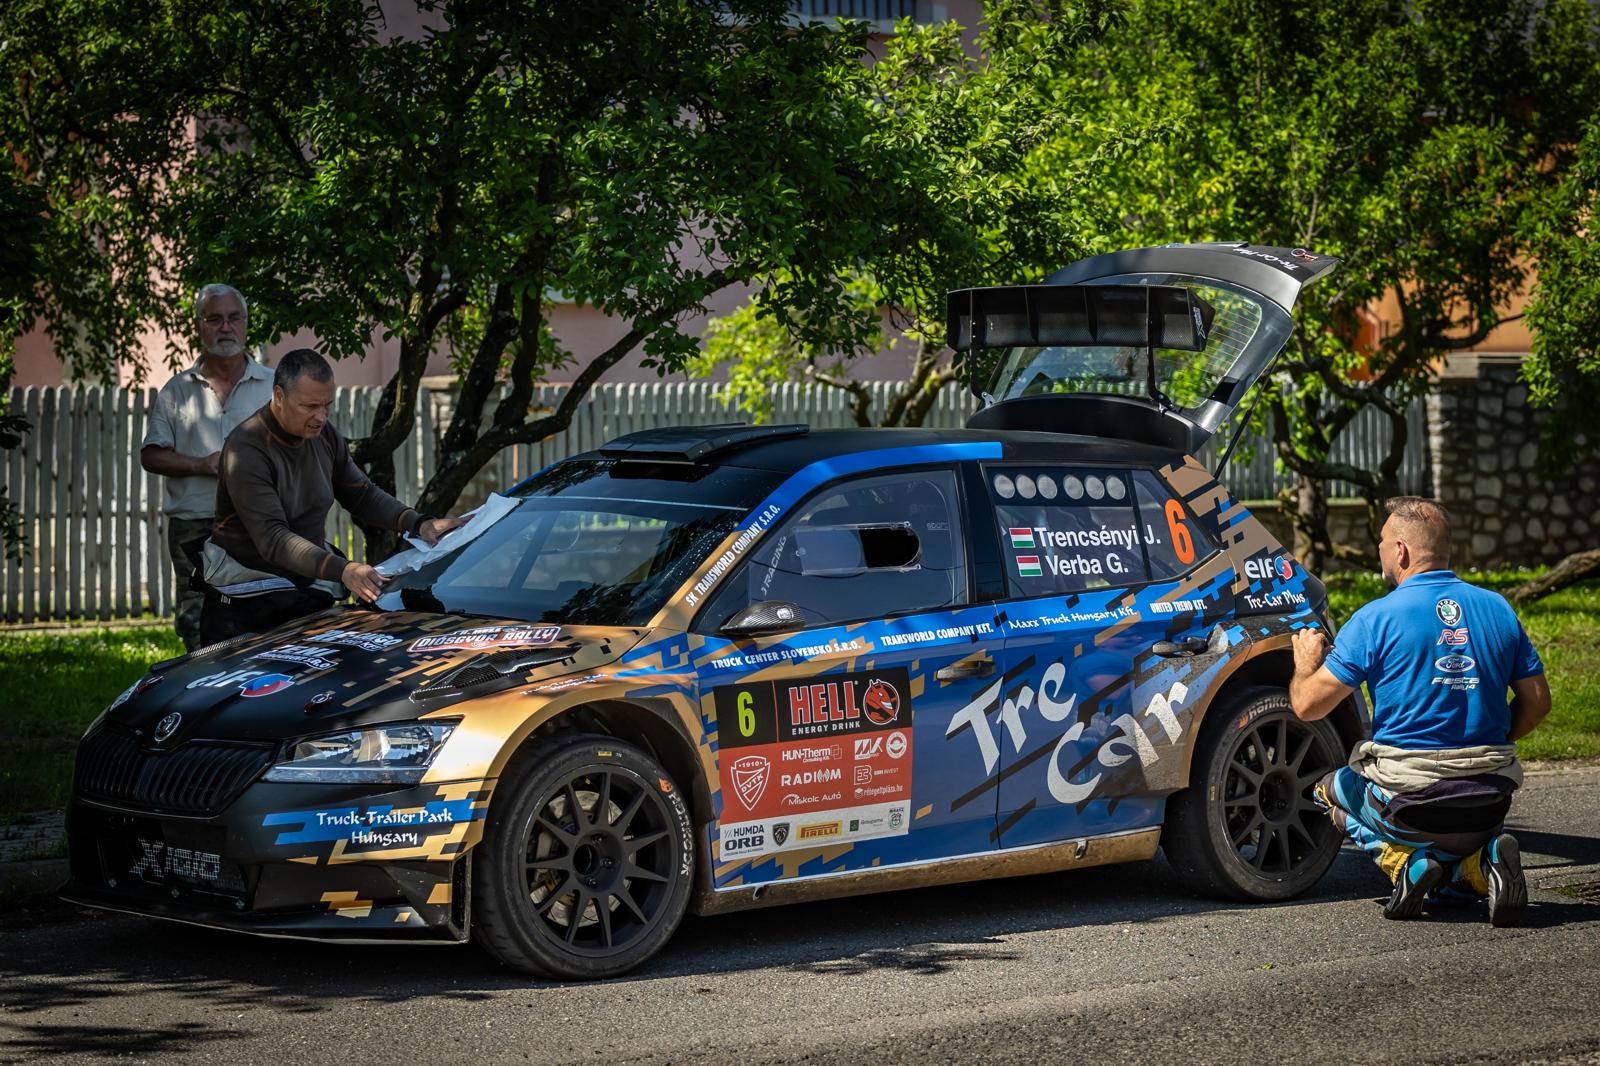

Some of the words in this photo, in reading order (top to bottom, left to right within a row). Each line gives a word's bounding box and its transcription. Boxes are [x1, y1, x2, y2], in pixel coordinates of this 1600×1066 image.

[1033, 525, 1140, 551] Trencsényi
[1143, 524, 1161, 544] J.
[1164, 498, 1195, 564] 6
[685, 594, 699, 607] SK
[694, 551, 736, 596] TRANSWORLD
[731, 521, 763, 555] COMPANY
[759, 504, 781, 526] S.R.O.
[1044, 554, 1103, 576] Verba
[1105, 552, 1128, 573] G.
[1244, 558, 1274, 579] elf
[1149, 601, 1171, 614] UNITED
[1172, 600, 1193, 612] TREND
[1244, 593, 1283, 608] Tre-Car
[1282, 589, 1306, 605] Plus
[1039, 613, 1071, 626] Truck
[1071, 608, 1118, 622] Hungary
[1117, 605, 1138, 617] Kft.
[503, 628, 554, 641] RALLY
[880, 630, 936, 646] TRANSWORLD
[936, 625, 975, 639] COMPANY
[976, 622, 994, 634] KFT.
[1436, 627, 1469, 645] RS
[711, 656, 743, 669] TRUCK
[744, 651, 780, 664] CENTER
[780, 644, 832, 660] SLOVENSKO
[834, 639, 861, 653] S.R.O.
[1445, 657, 1465, 669] Ford
[788, 681, 861, 725] HELL
[737, 691, 756, 738] 6
[945, 662, 1076, 777] Tre
[791, 724, 829, 736] ENERGY
[832, 720, 861, 731] DRINK
[1047, 681, 1189, 804] Car
[741, 774, 765, 793] DVTK
[821, 791, 842, 801] Autó
[316, 810, 416, 826] Truck-Trailer
[419, 807, 453, 823] Park
[351, 830, 418, 847] Hungary
[733, 824, 765, 837] HUMDA
[725, 835, 764, 851] ORB
